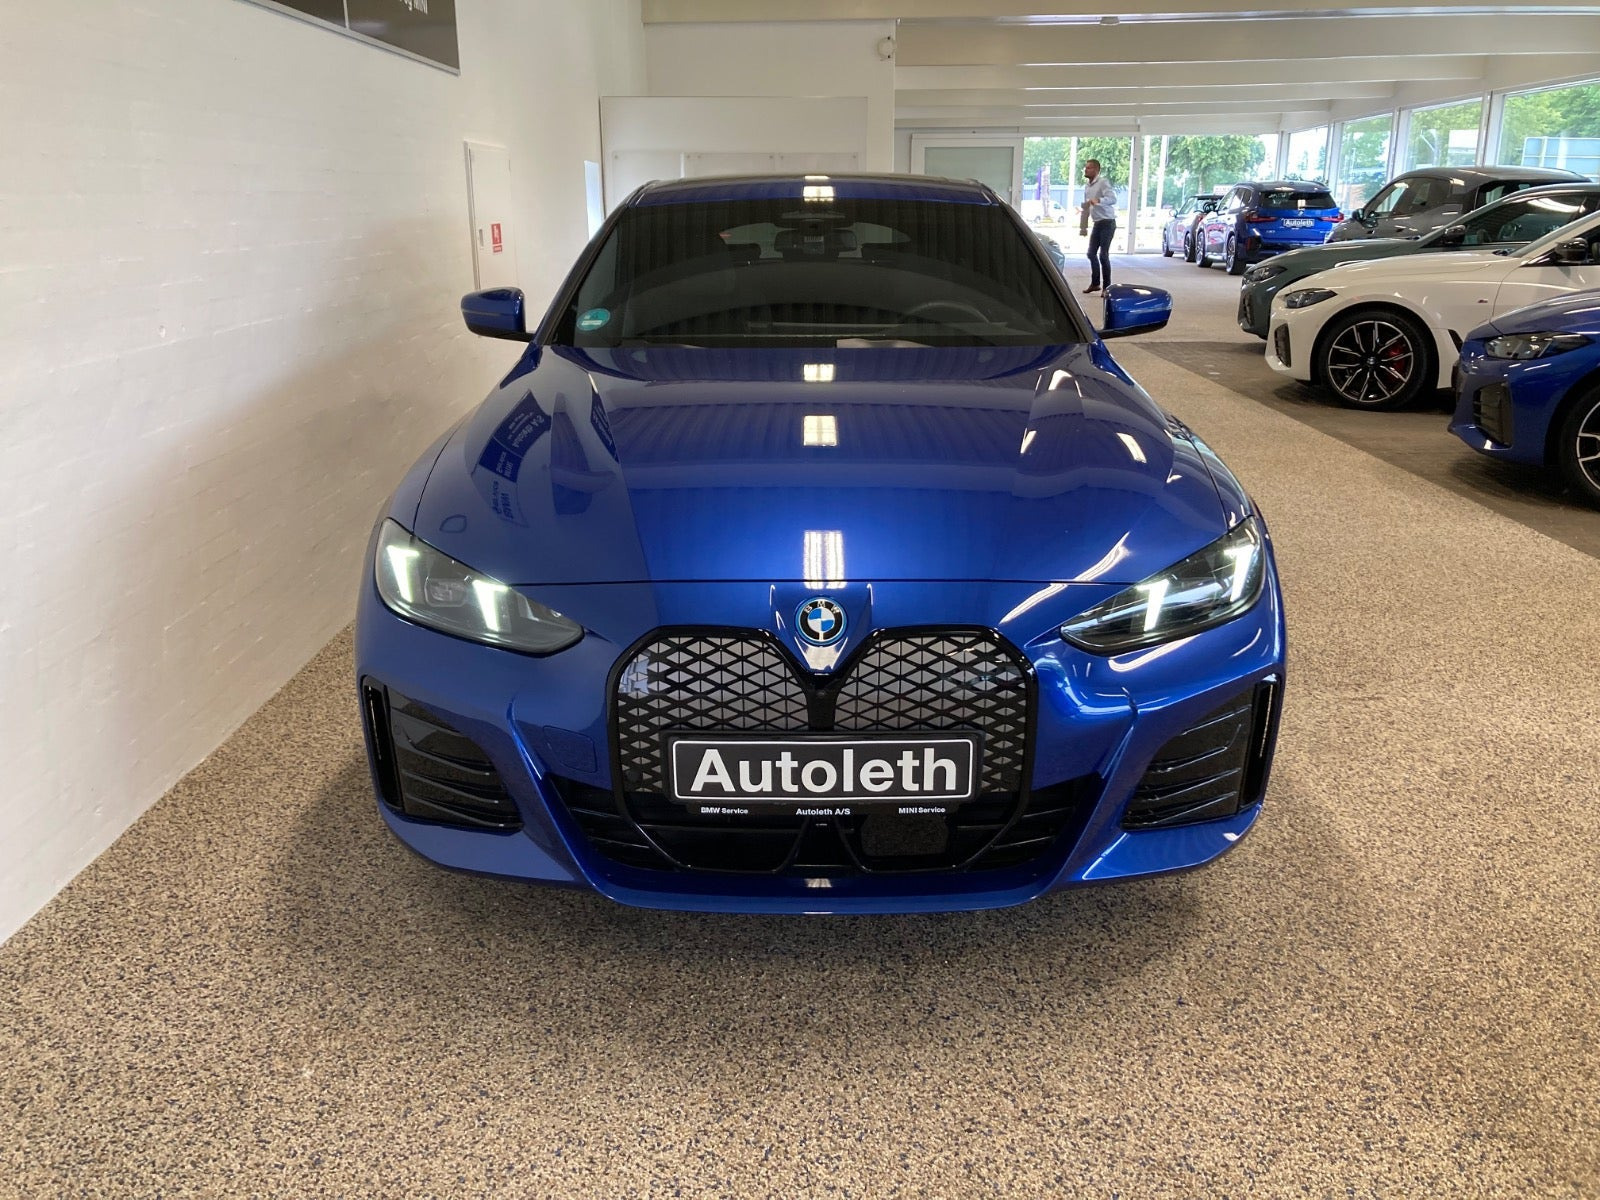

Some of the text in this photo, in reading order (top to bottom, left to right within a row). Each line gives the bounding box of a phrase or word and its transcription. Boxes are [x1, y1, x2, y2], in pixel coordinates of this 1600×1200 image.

[804, 600, 840, 614] BMW
[690, 747, 957, 793] Autoleth
[700, 806, 720, 814] BMW
[796, 807, 851, 816] Autoleth A/S
[898, 806, 946, 814] MINI Service
